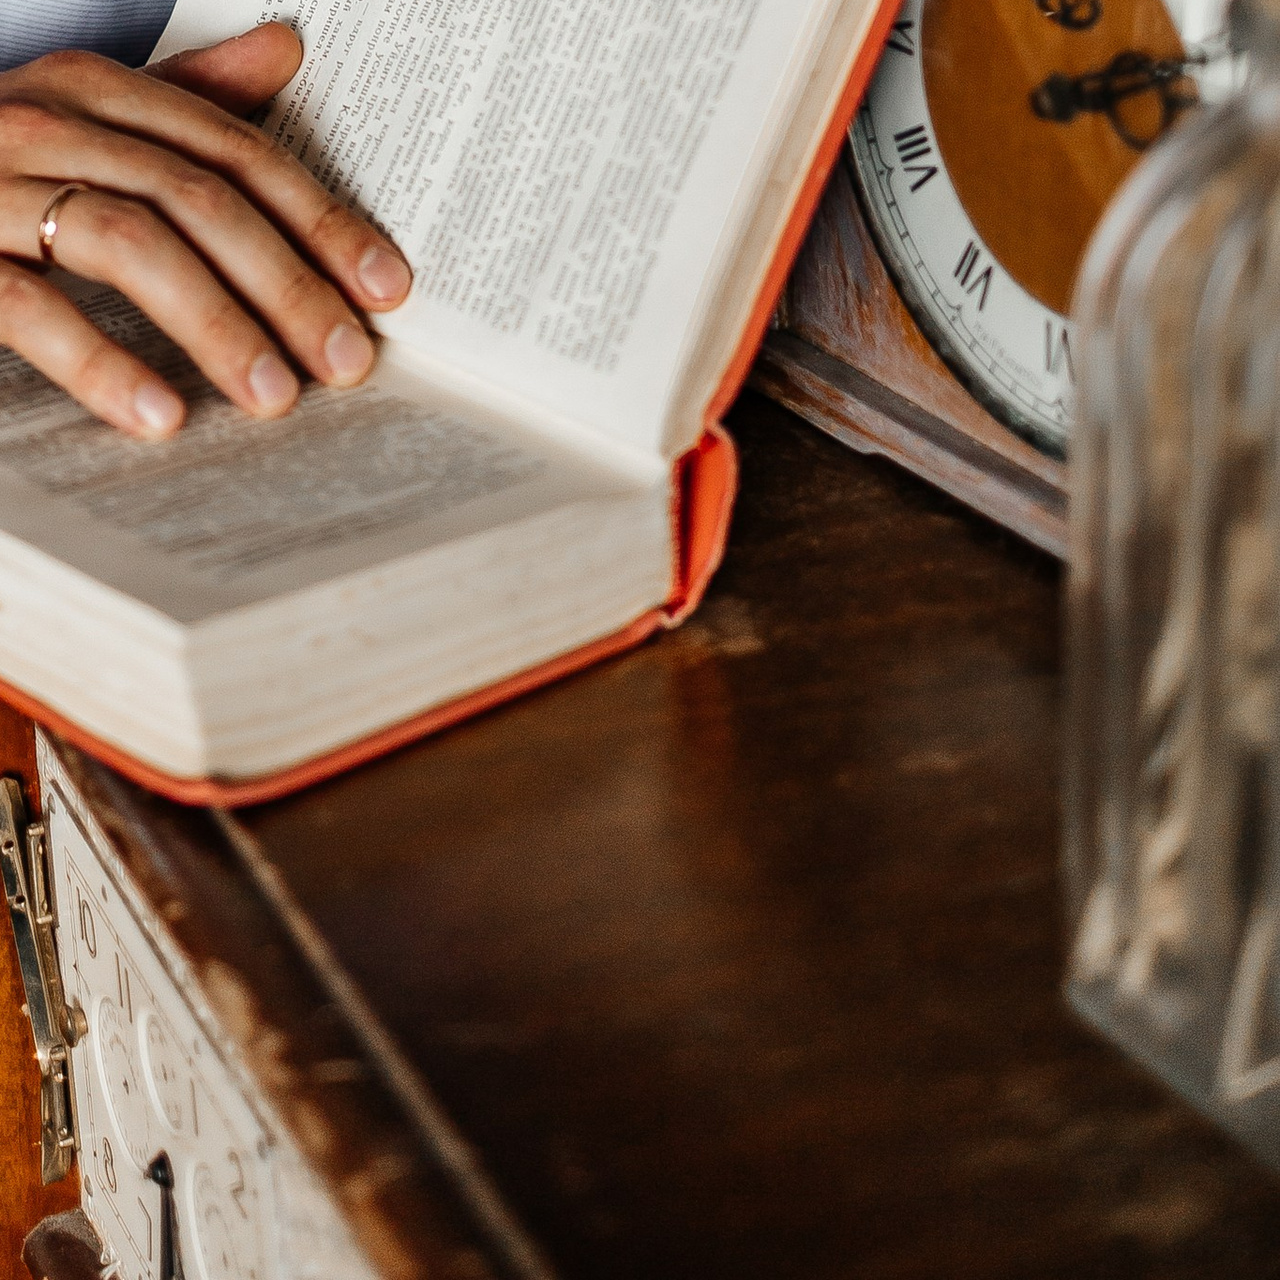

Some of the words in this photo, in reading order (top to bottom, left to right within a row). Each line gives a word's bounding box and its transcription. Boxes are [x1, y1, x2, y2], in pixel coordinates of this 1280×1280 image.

[251, 8, 269, 27] му
[311, 0, 341, 53] пришел,
[318, 18, 344, 62] хаким,
[342, 18, 363, 57] вдруг
[381, 0, 407, 44] хотите
[293, 57, 316, 97] чтобы
[346, 18, 386, 97] понравится.
[375, 40, 404, 89] Уйдите
[388, 52, 421, 115] вскричал
[389, 34, 417, 85] взошло
[413, 33, 440, 85] слепец!
[289, 79, 317, 127] сказал
[313, 59, 344, 121] раздался
[349, 50, 384, 118] услышать
[372, 96, 390, 122] над
[272, 98, 298, 142] испыт
[314, 101, 352, 161] Клянусь
[352, 92, 379, 135] прочь,
[315, 121, 352, 187] приказан
[340, 139, 357, 162] вы,
[340, 130, 375, 189] позором
[360, 122, 390, 172] король,
[894, 125, 938, 193] VIII
[324, 165, 346, 196] дам
[346, 181, 366, 211] топ
[365, 142, 406, 214] невозврат
[954, 241, 993, 311] VII
[75, 885, 97, 959] 10
[115, 951, 133, 1024] 11
[103, 1136, 117, 1194] 8
[137, 1195, 153, 1262] 7
